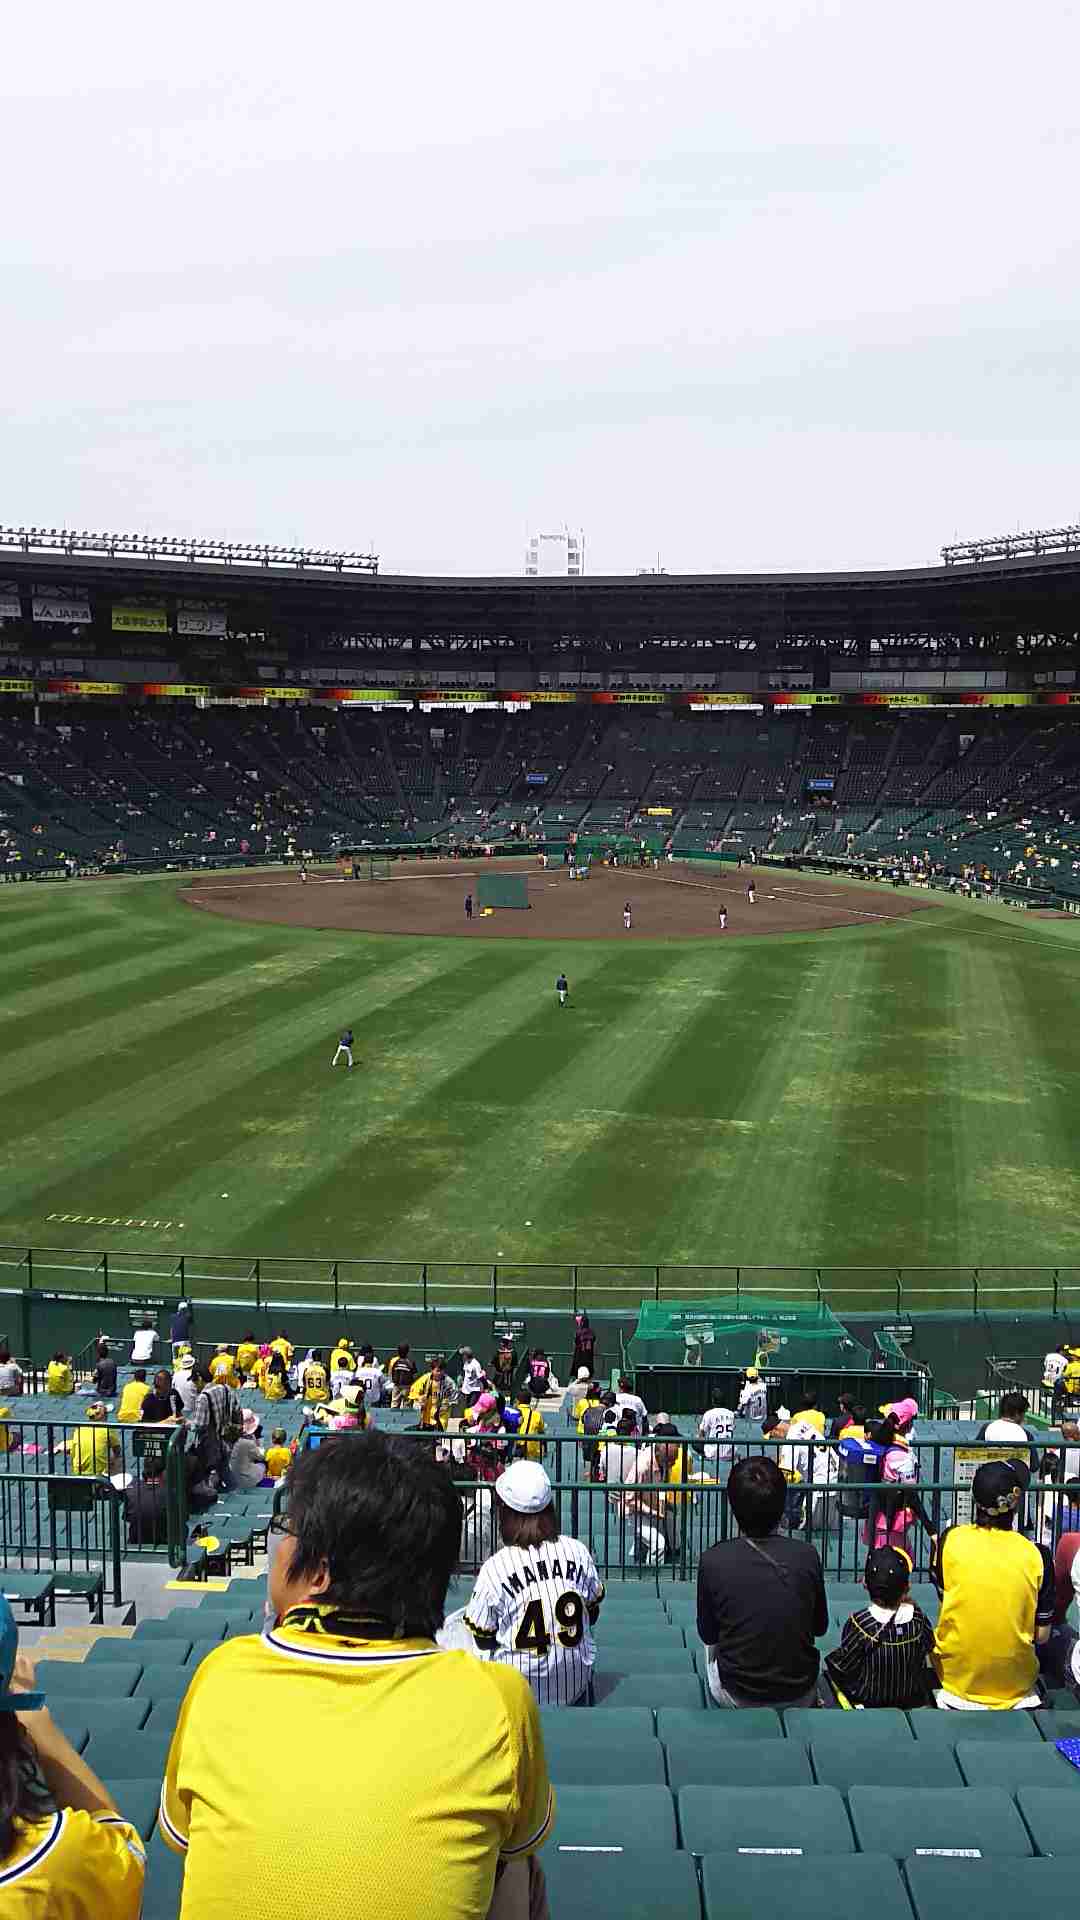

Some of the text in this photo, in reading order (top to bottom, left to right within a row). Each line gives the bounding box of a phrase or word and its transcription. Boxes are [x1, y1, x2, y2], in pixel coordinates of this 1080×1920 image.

[307, 1377, 322, 1389] 63
[715, 1424, 734, 1440] 25
[501, 1559, 584, 1599] IMANARI
[514, 1591, 584, 1655] 49
